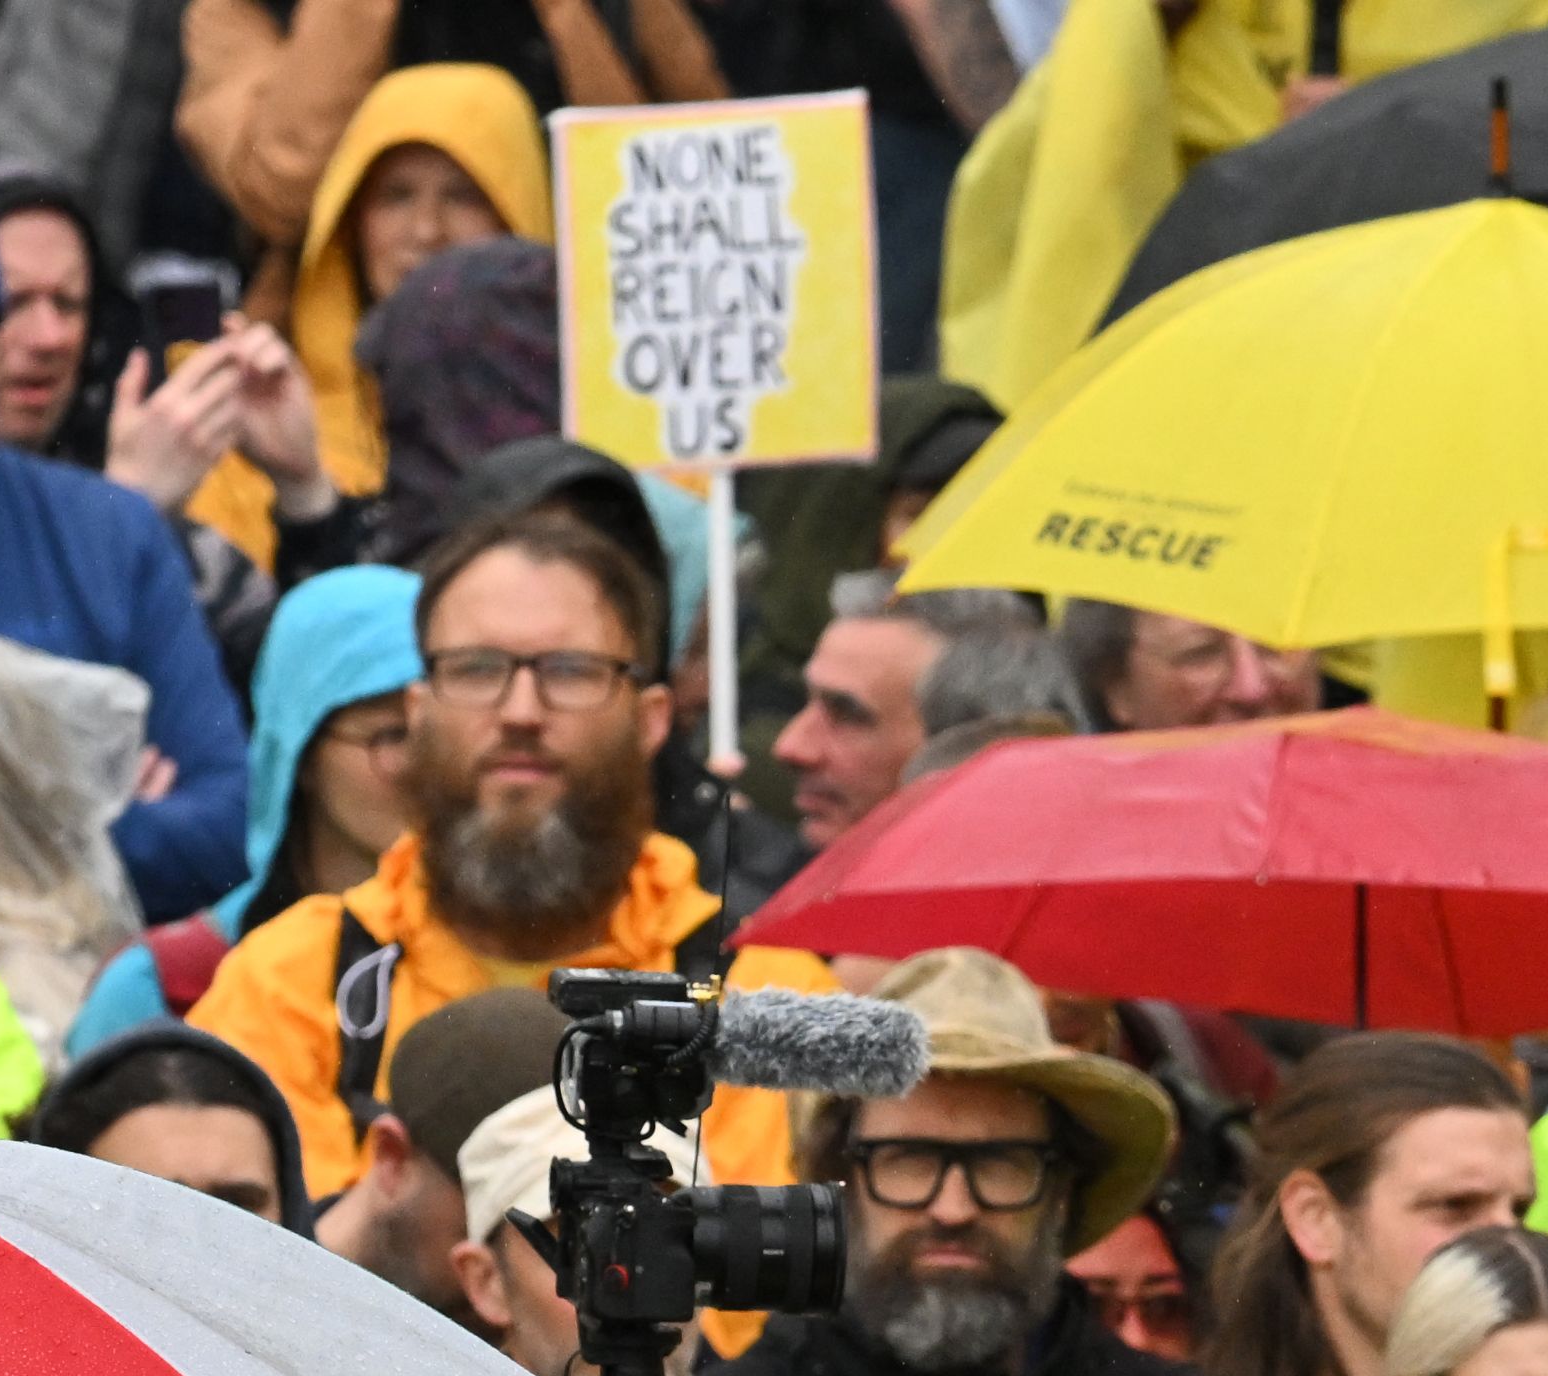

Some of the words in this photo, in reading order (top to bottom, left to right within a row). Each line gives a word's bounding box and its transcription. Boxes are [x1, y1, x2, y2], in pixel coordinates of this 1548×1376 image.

[630, 126, 778, 193] NONE
[609, 192, 801, 257] SHALL
[612, 256, 788, 327] REIGN
[623, 320, 787, 394] OVER
[667, 397, 744, 458] US
[1036, 510, 1227, 571] RESCUE
